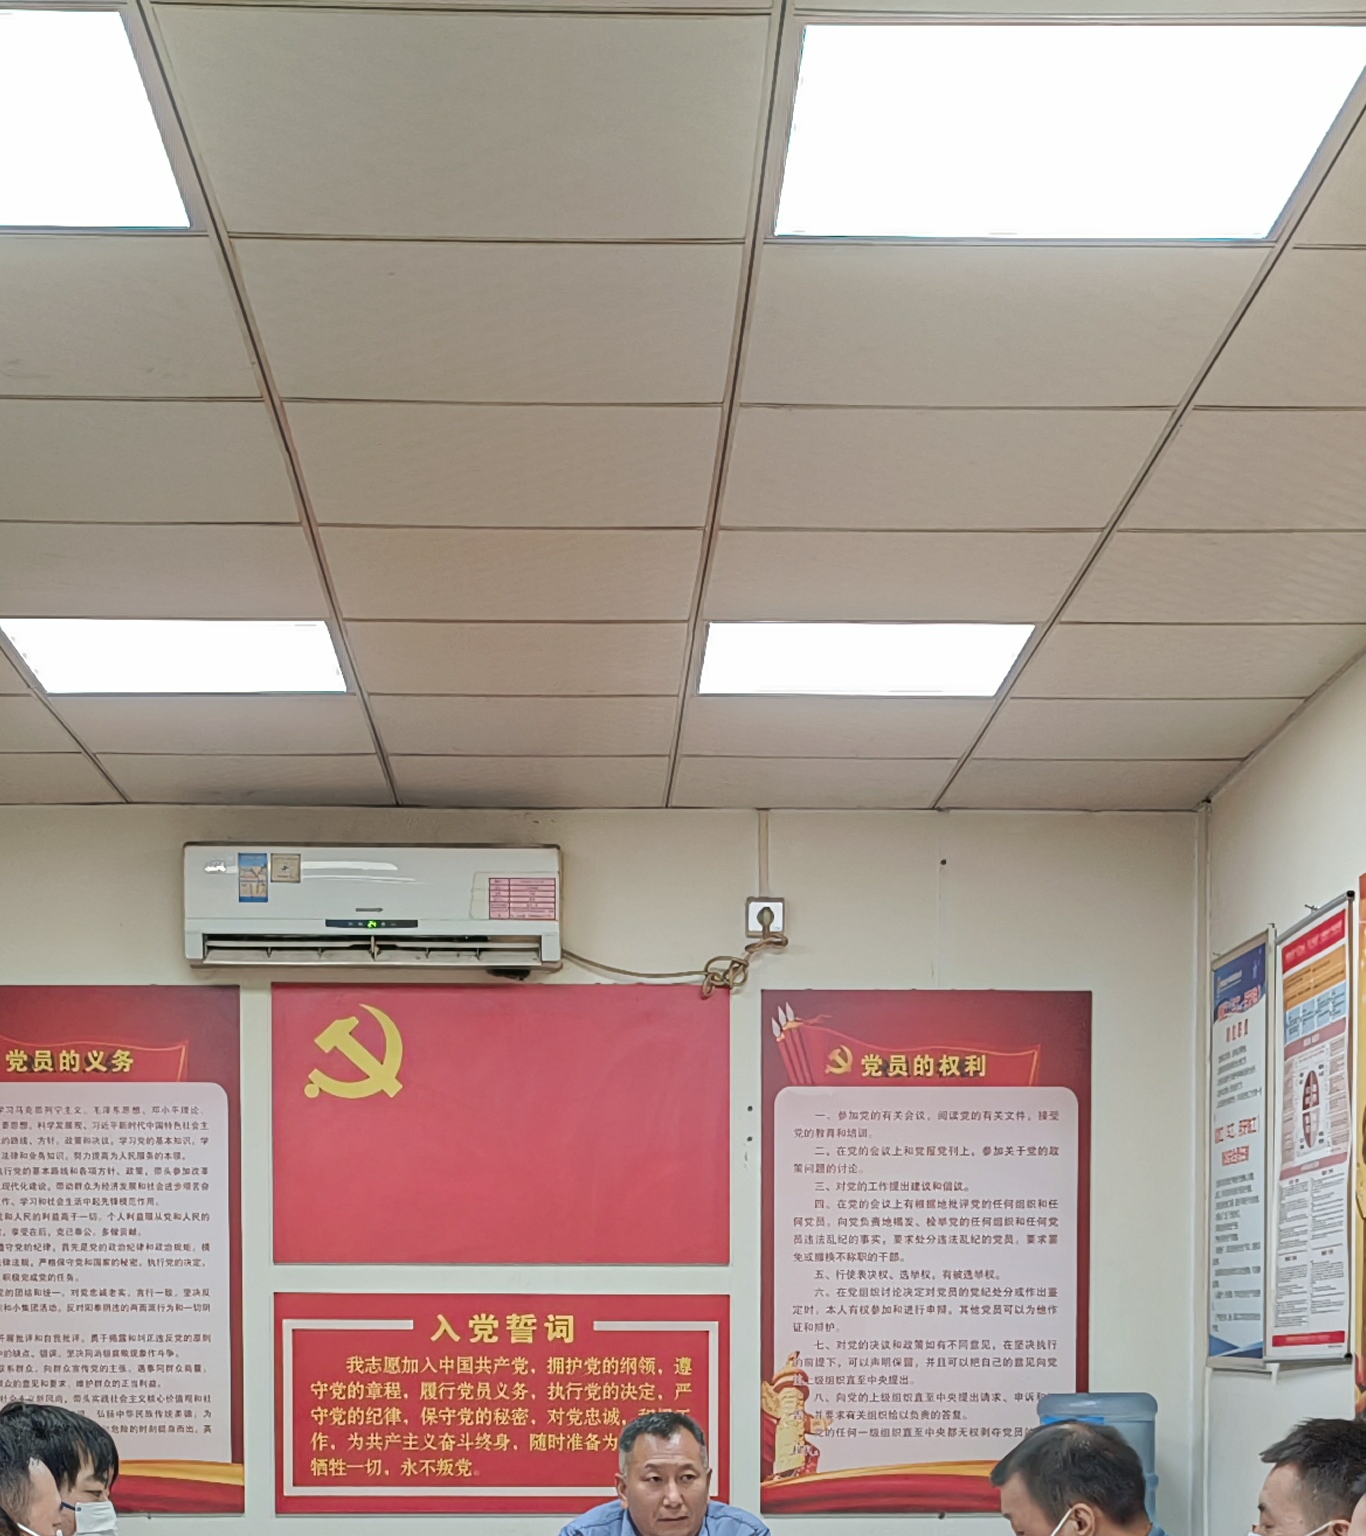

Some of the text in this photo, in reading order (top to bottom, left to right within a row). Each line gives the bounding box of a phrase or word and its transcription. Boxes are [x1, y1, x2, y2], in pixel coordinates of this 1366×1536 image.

[5, 1049, 135, 1074] 党员的义务
[861, 1054, 987, 1078] 党员的权利
[430, 1313, 575, 1343] 入党誓词
[346, 1355, 693, 1375] 我志愿加入中国共产党，拥护党的纲领，遵
[310, 1381, 693, 1401] 守党的章程，履行党员义务，执行党的决定，严
[310, 1407, 691, 1426] 守党的纪律，保守党的秘密，对党忠诚，
[310, 1458, 480, 1477] 牺牲一切，永不叛党。
